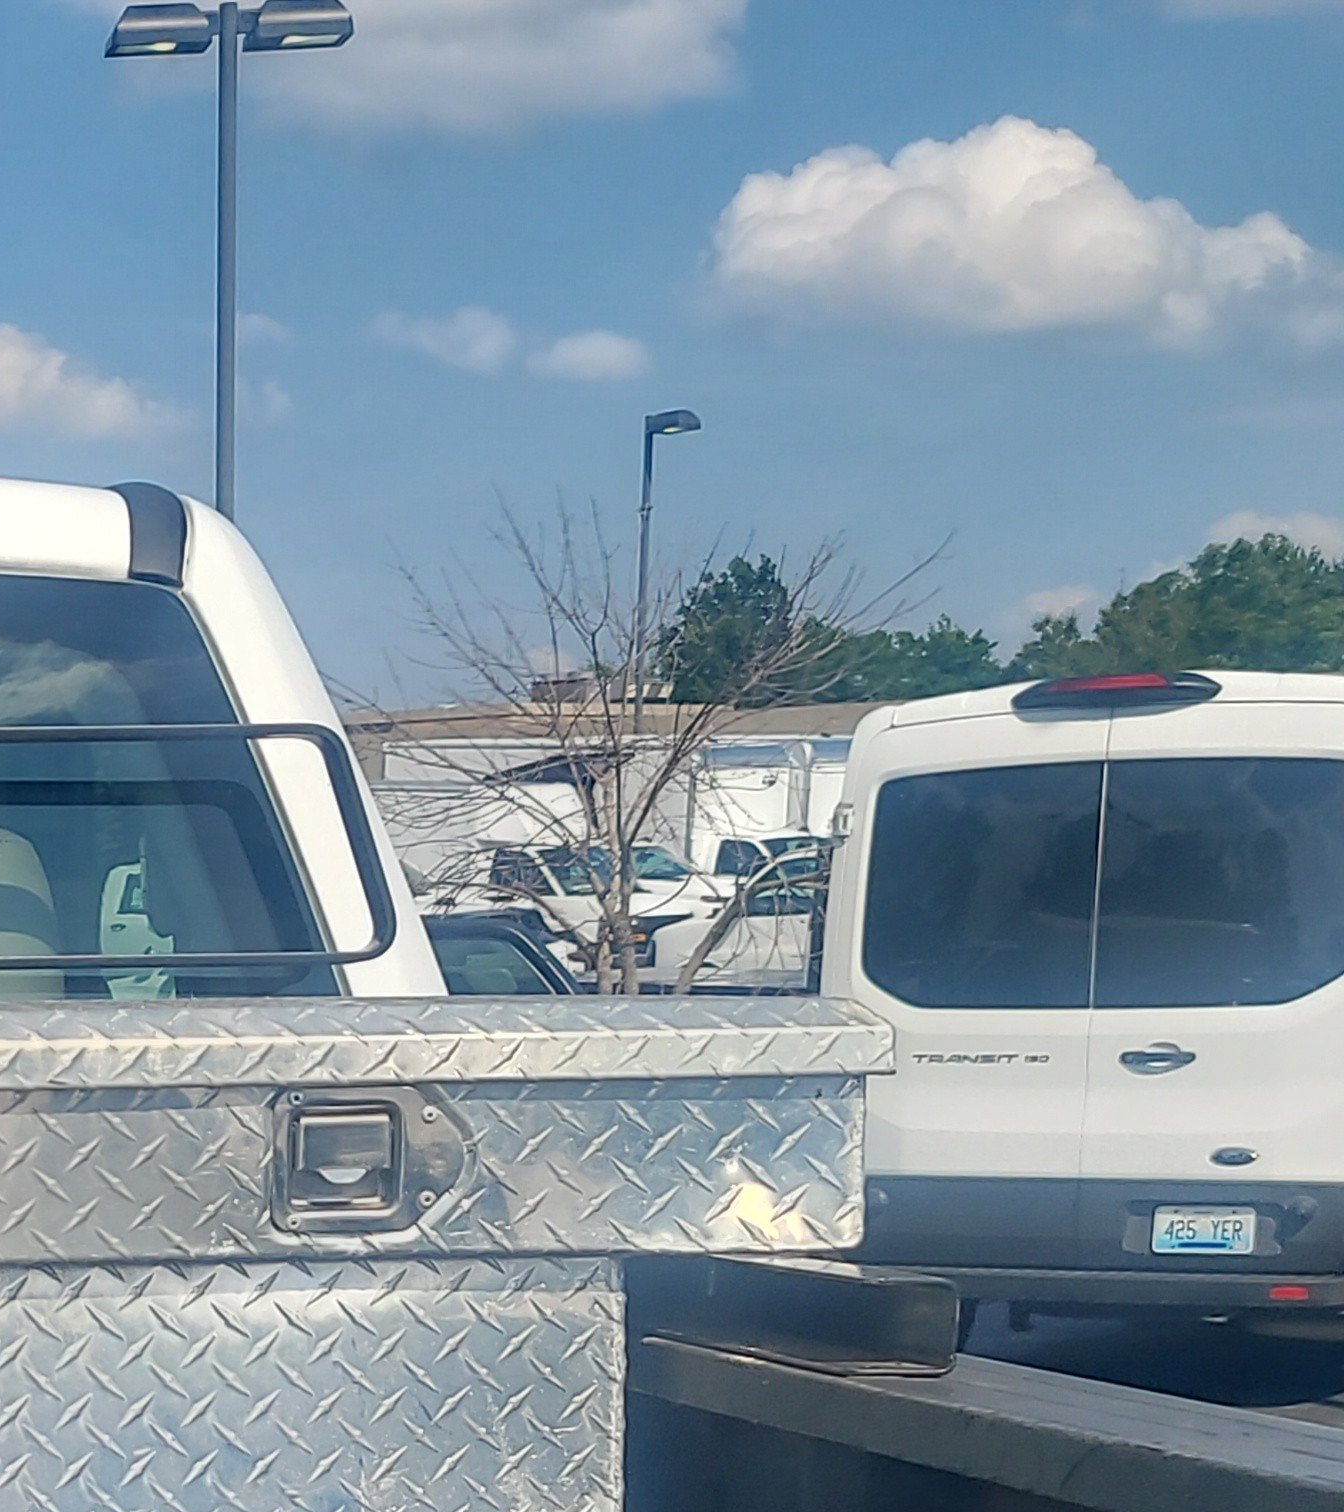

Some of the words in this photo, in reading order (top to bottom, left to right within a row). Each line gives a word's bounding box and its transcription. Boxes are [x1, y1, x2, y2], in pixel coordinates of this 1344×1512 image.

[911, 1053, 1019, 1065] TRANSIT
[1164, 1219, 1197, 1241] 425
[1210, 1219, 1244, 1242] YER
